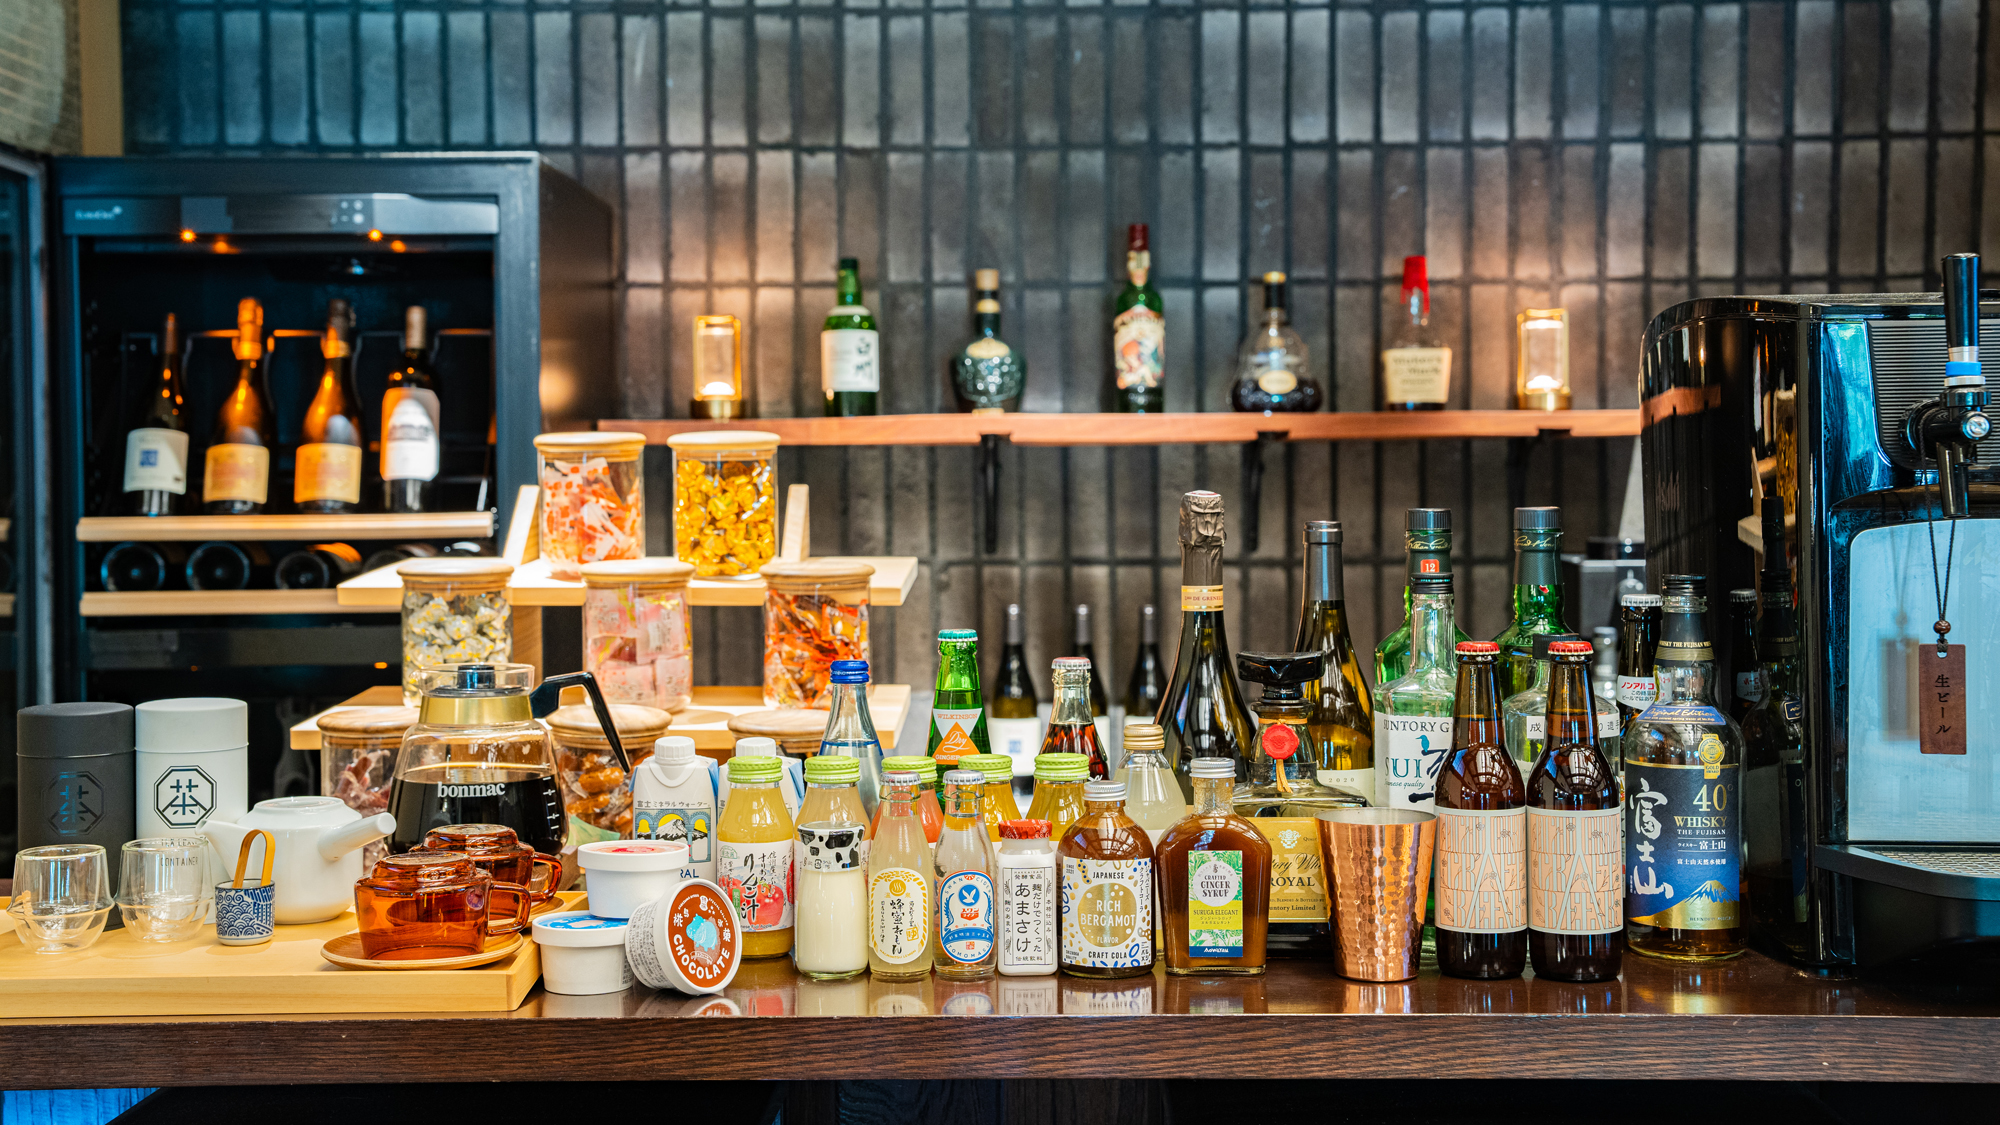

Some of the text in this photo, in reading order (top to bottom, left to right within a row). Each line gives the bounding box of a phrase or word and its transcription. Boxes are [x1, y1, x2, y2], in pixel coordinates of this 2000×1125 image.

[1425, 563, 1436, 572] 12
[1935, 674, 1951, 734] 生ビール
[943, 731, 970, 753] Dry
[1385, 757, 1422, 779] SUI
[437, 781, 506, 798] bonmac
[1403, 780, 1425, 791] quality
[1673, 815, 1728, 828] WHISKY
[1630, 777, 1675, 900] 富士山
[1699, 840, 1727, 851] 富士山
[1677, 858, 1727, 866] 富士山天然水使用
[945, 877, 963, 895] SWAN
[1200, 880, 1231, 889] GINGER
[1202, 889, 1229, 898] SYRUP
[1096, 899, 1121, 912] RICH
[1015, 882, 1031, 953] あまさけ
[1080, 913, 1135, 927] BERGAMOT
[1097, 936, 1119, 944] FLAVOR
[673, 934, 730, 980] CHOCOLATE
[947, 943, 990, 959] TOMOMASU
[1088, 951, 1127, 959] CRAFT COLA
